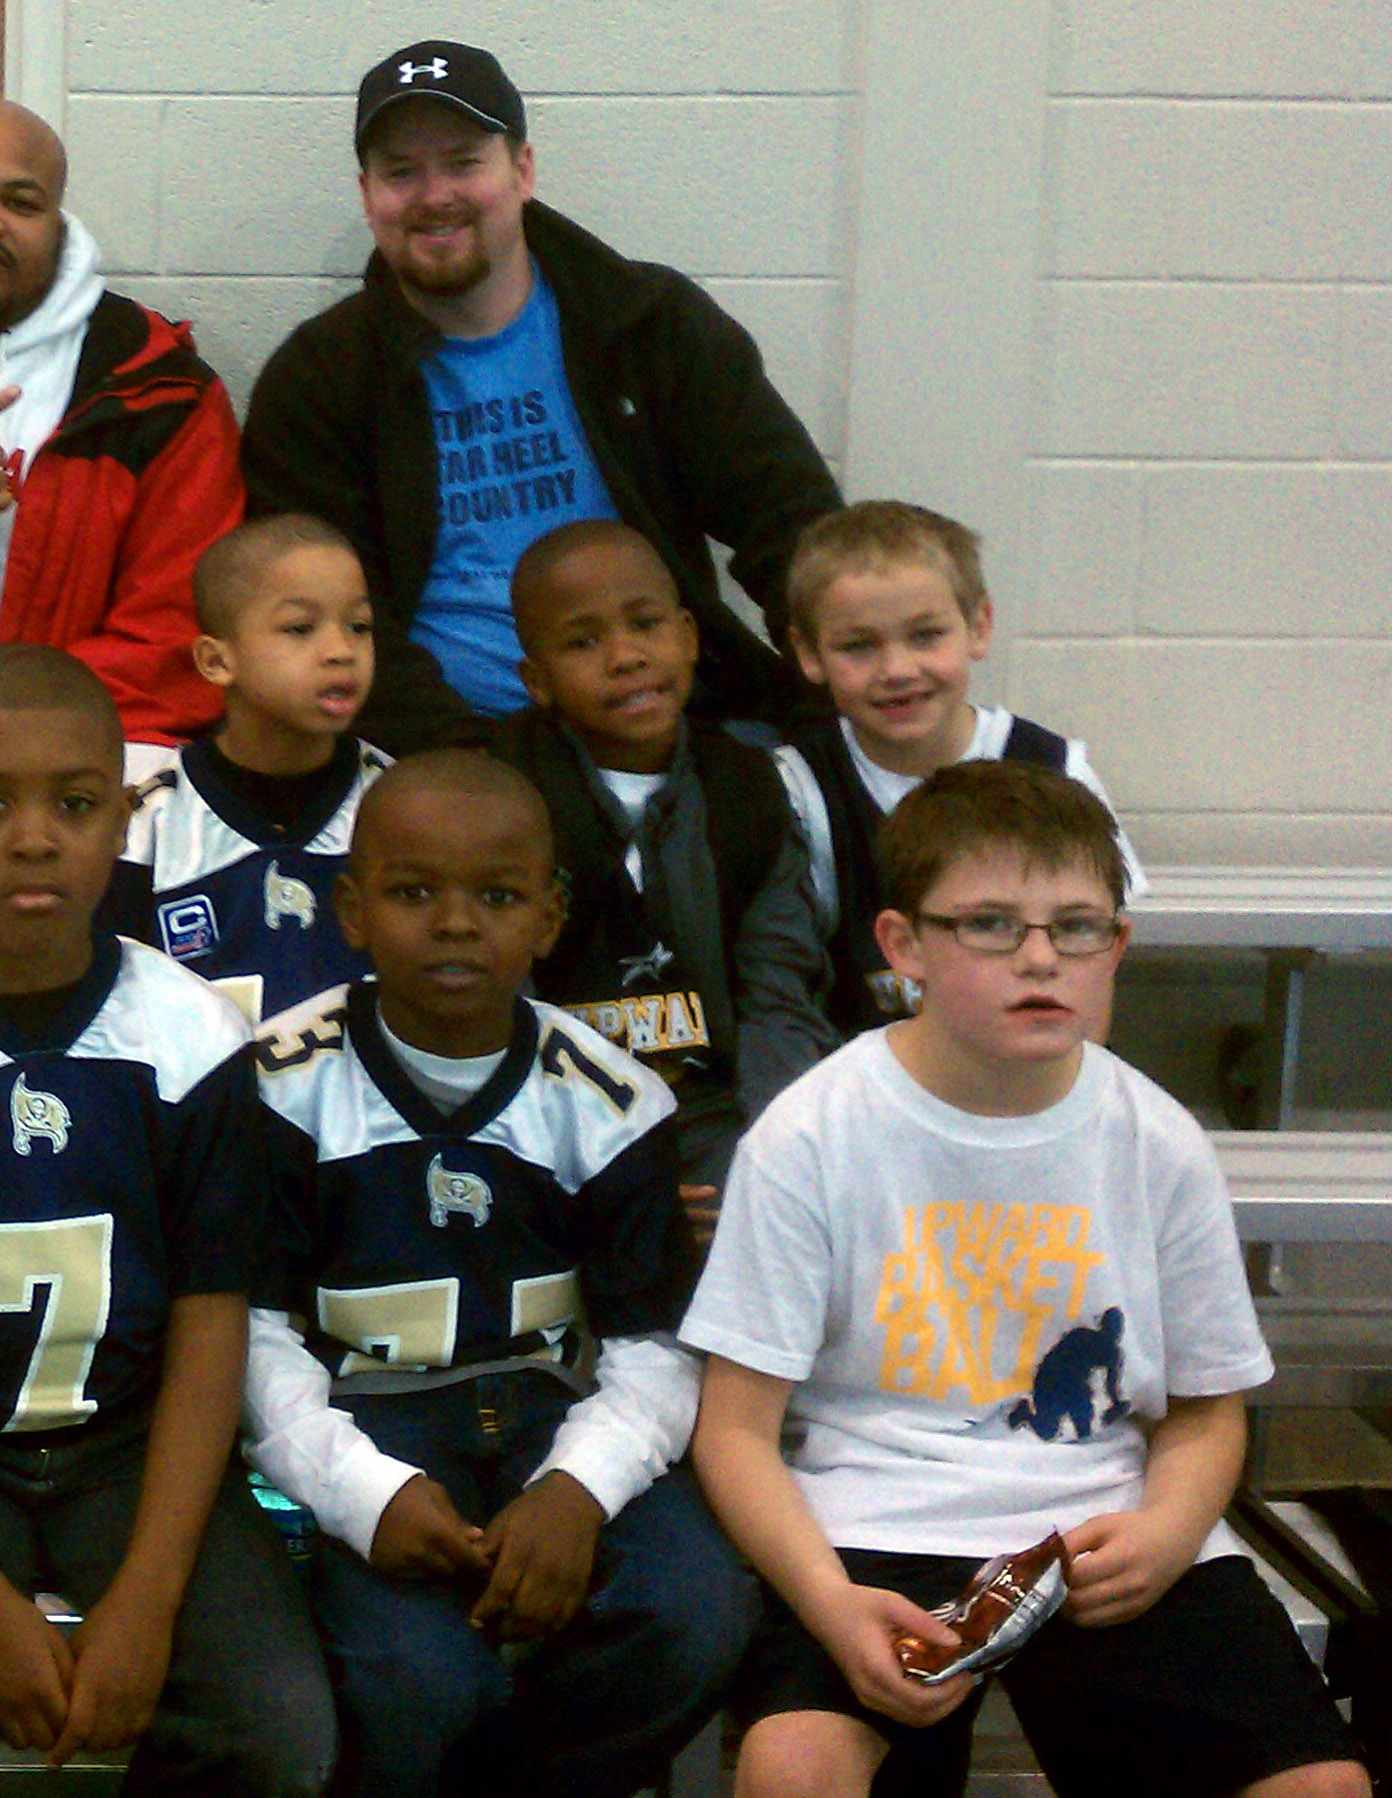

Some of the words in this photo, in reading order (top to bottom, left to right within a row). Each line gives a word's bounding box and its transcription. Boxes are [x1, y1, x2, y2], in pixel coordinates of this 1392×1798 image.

[435, 399, 506, 442] THIS
[511, 390, 547, 428] IS
[491, 431, 568, 477] HEEL
[439, 468, 577, 526] OUNTRY
[167, 904, 208, 935] C
